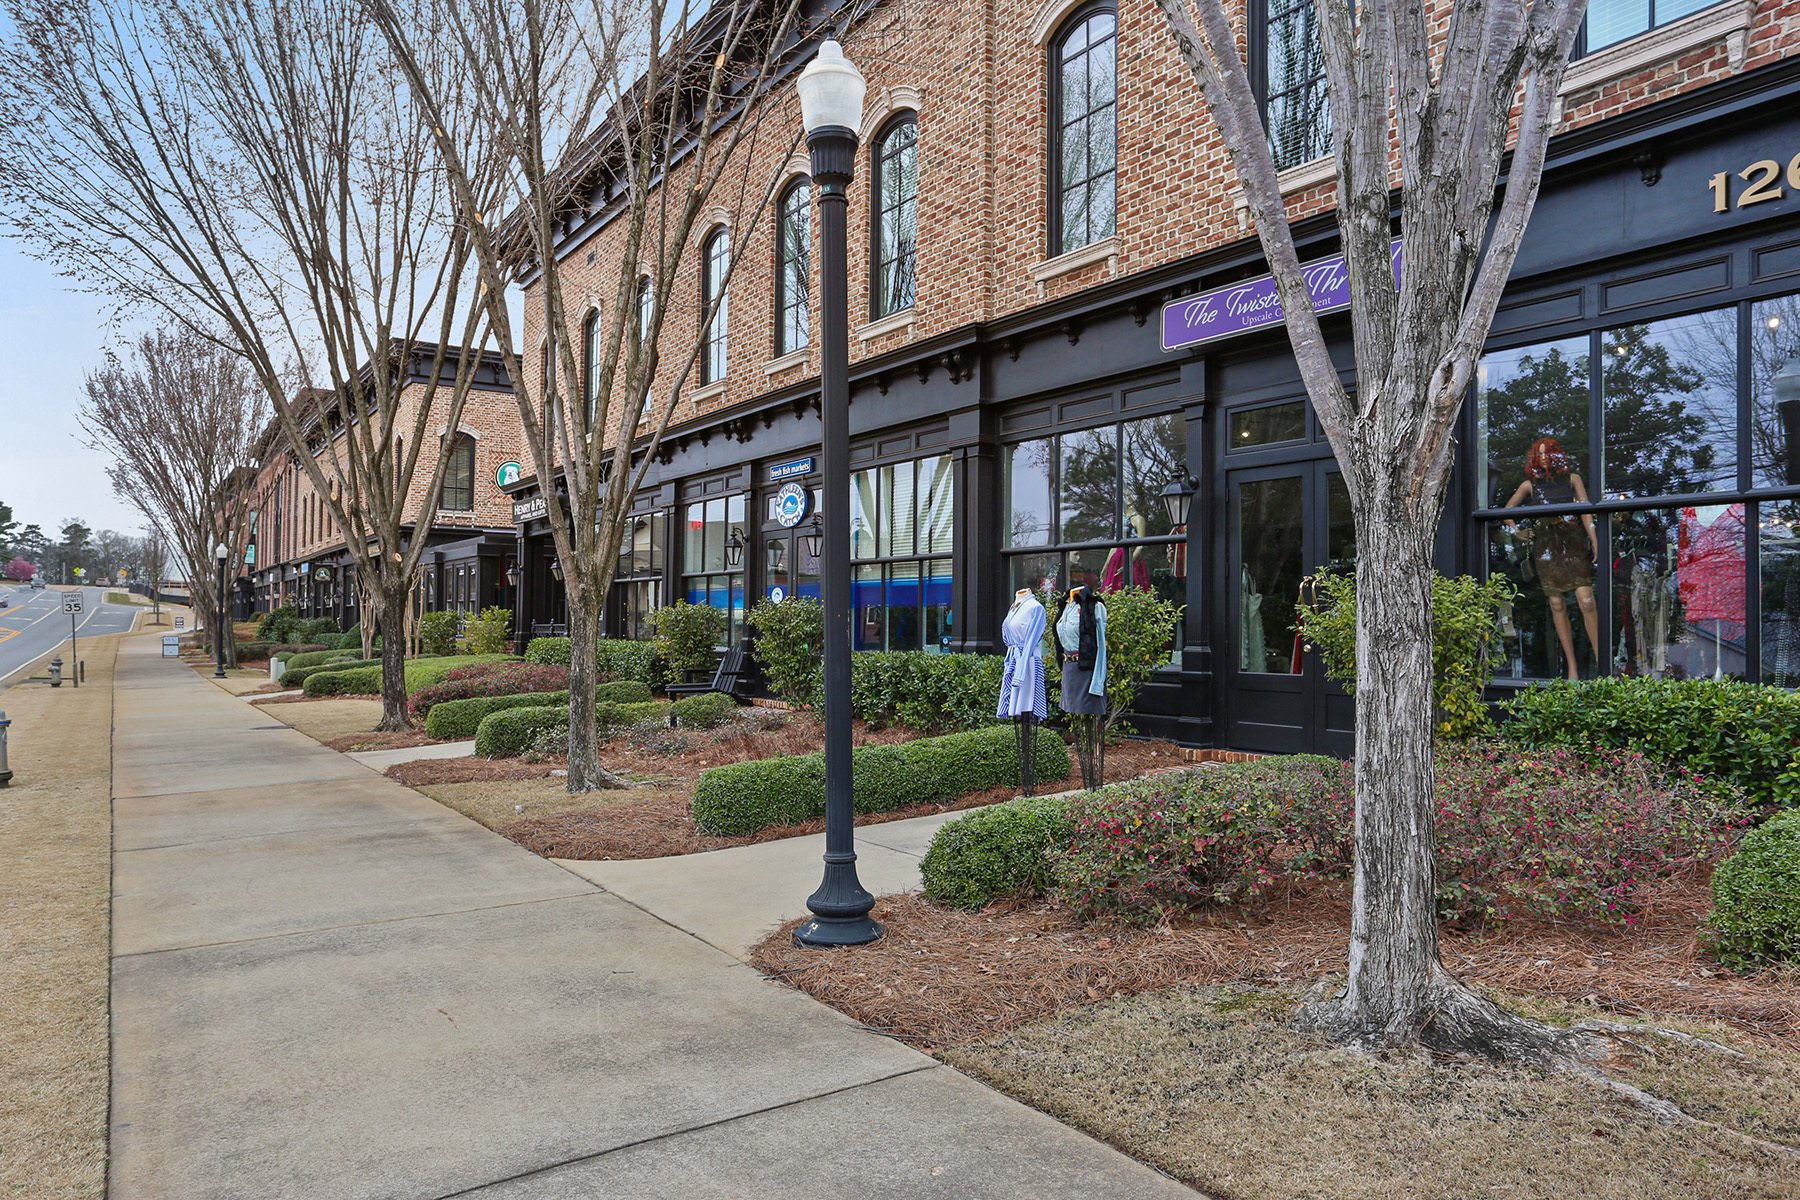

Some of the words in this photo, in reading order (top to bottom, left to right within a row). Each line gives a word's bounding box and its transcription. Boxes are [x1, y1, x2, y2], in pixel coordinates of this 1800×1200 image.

[1184, 297, 1218, 328] The
[1242, 311, 1273, 326] Upscale
[771, 468, 782, 477] fresh
[782, 466, 791, 475] fish
[791, 463, 810, 473] markets
[514, 502, 531, 516] HENRY
[531, 500, 536, 511] &
[780, 511, 801, 526] CATCH
[65, 603, 81, 612] 35
